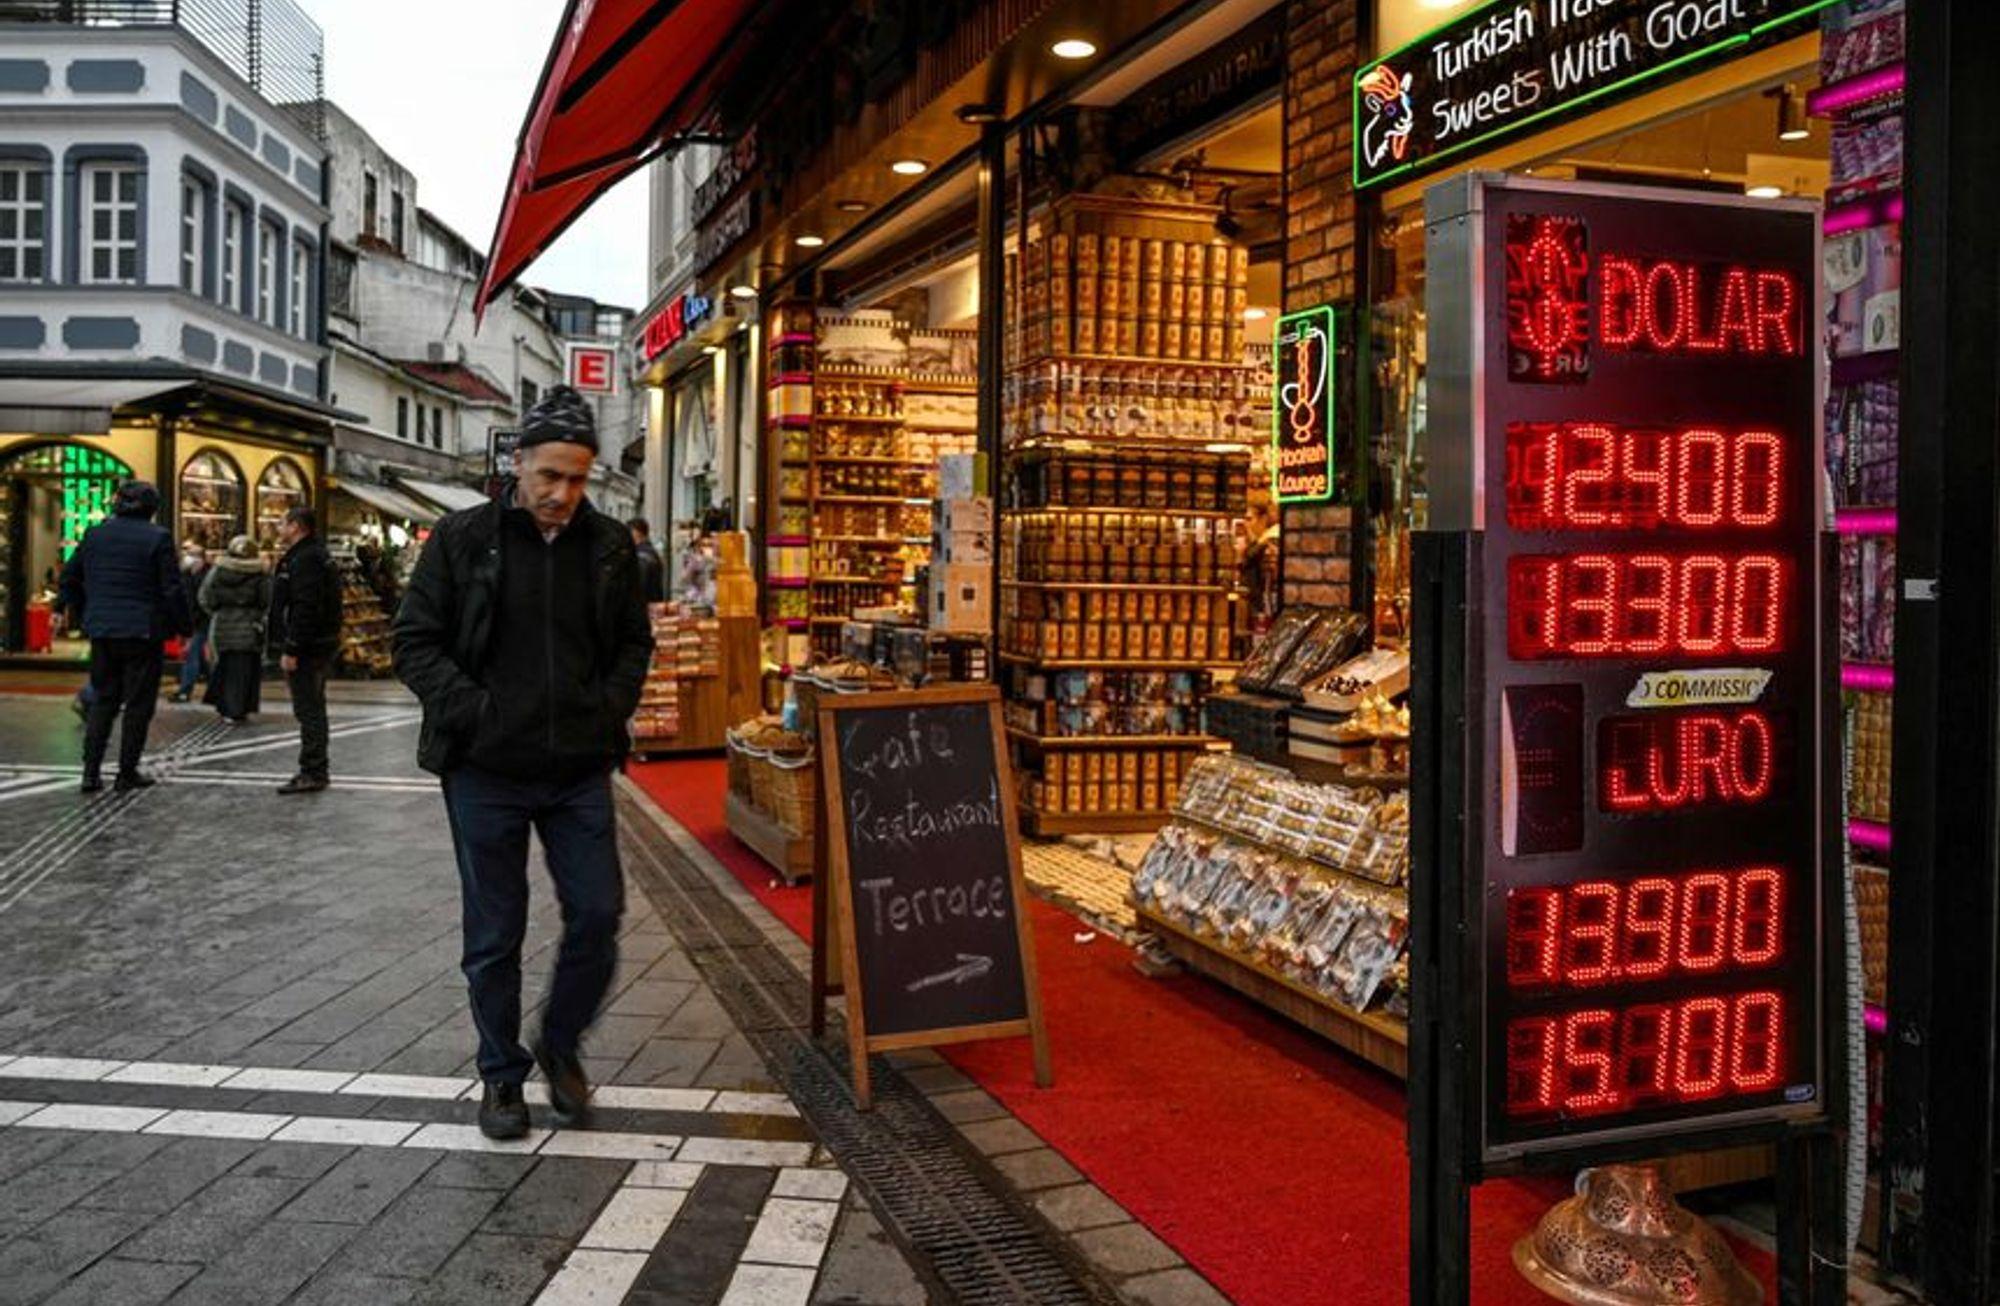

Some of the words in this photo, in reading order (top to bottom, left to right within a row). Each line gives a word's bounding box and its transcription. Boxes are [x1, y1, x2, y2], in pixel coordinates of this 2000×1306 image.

[1432, 5, 1534, 82] Turkish
[1432, 69, 1542, 140] Sweets
[1550, 28, 1631, 91] With
[1602, 260, 1793, 353] DOLAR
[580, 355, 605, 385] E
[1279, 473, 1325, 495] Lounge
[1543, 555, 1781, 652] 13.300
[859, 876, 1007, 936] Terrace
[1541, 868, 1781, 982] 13.900
[1540, 991, 1781, 1108] 15.100
